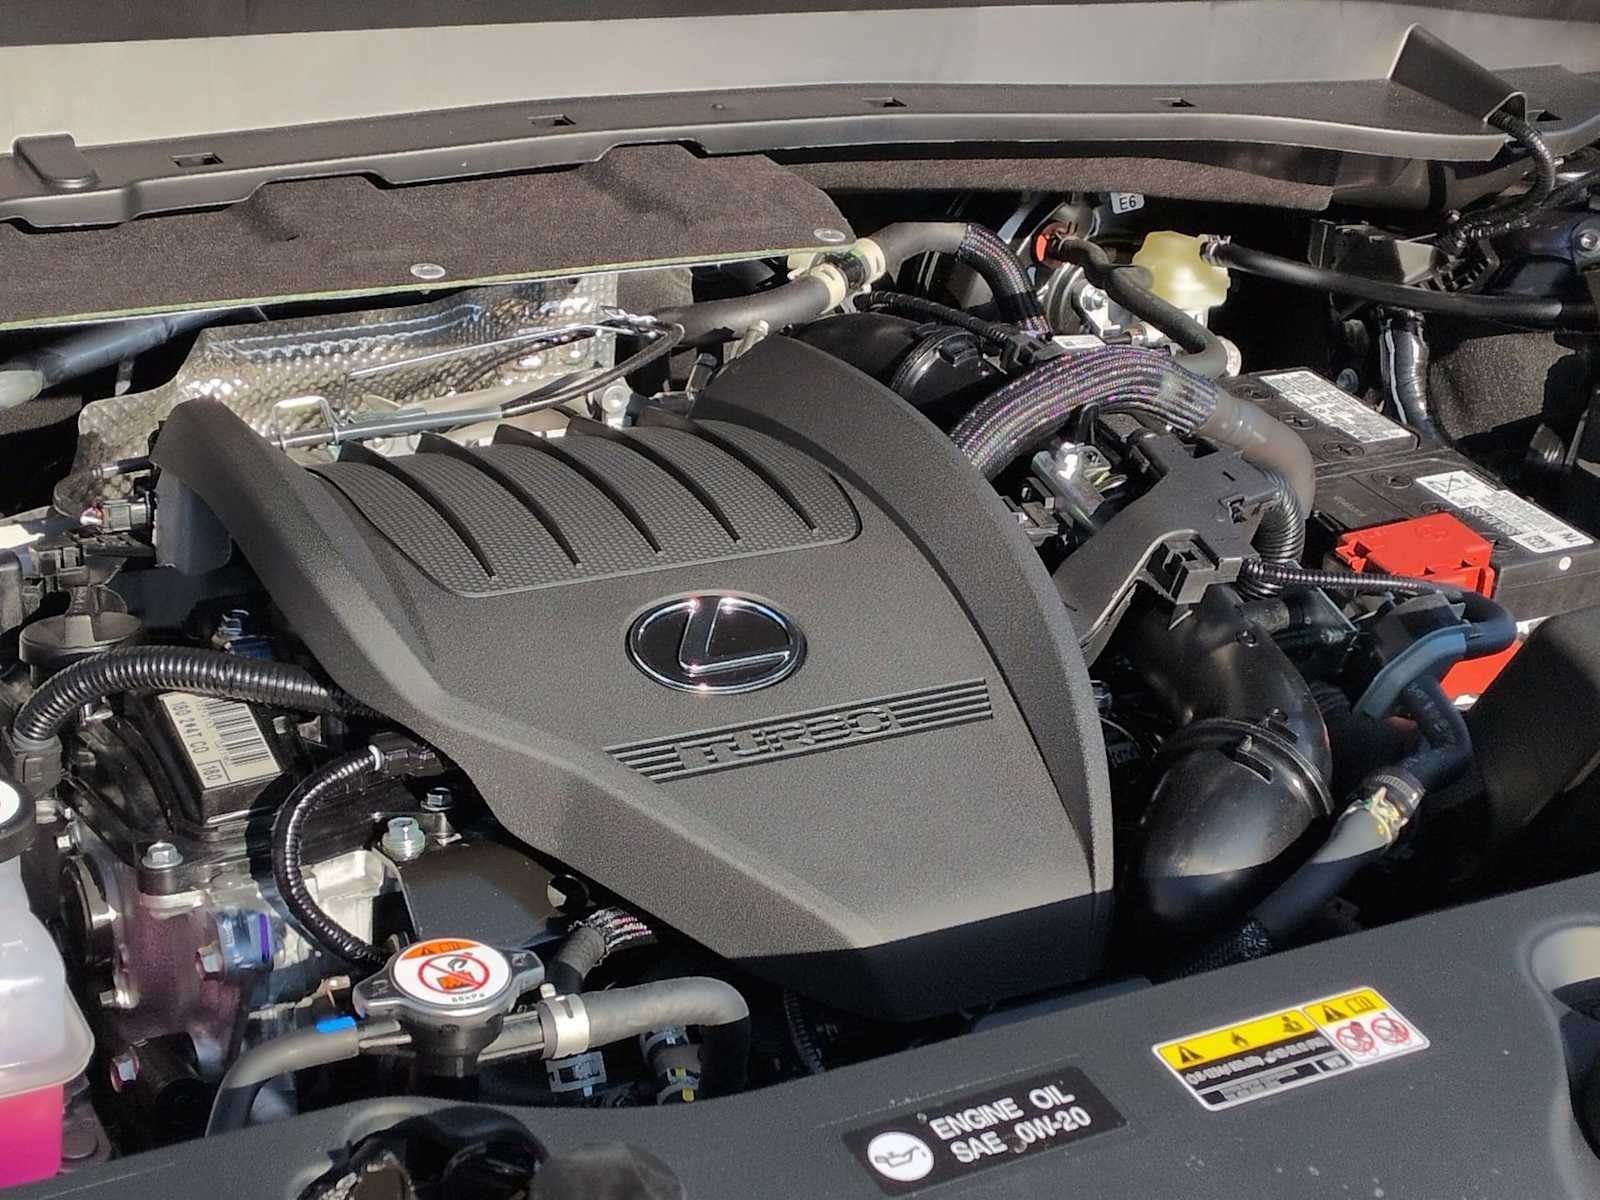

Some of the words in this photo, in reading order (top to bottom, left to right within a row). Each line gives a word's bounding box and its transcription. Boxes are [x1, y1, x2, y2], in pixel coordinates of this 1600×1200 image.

[1119, 195, 1137, 211] E6
[678, 706, 895, 763] TURBO
[929, 1097, 1024, 1140] ENGINE
[1029, 1084, 1076, 1110] OIL
[950, 1131, 1008, 1163] SAE
